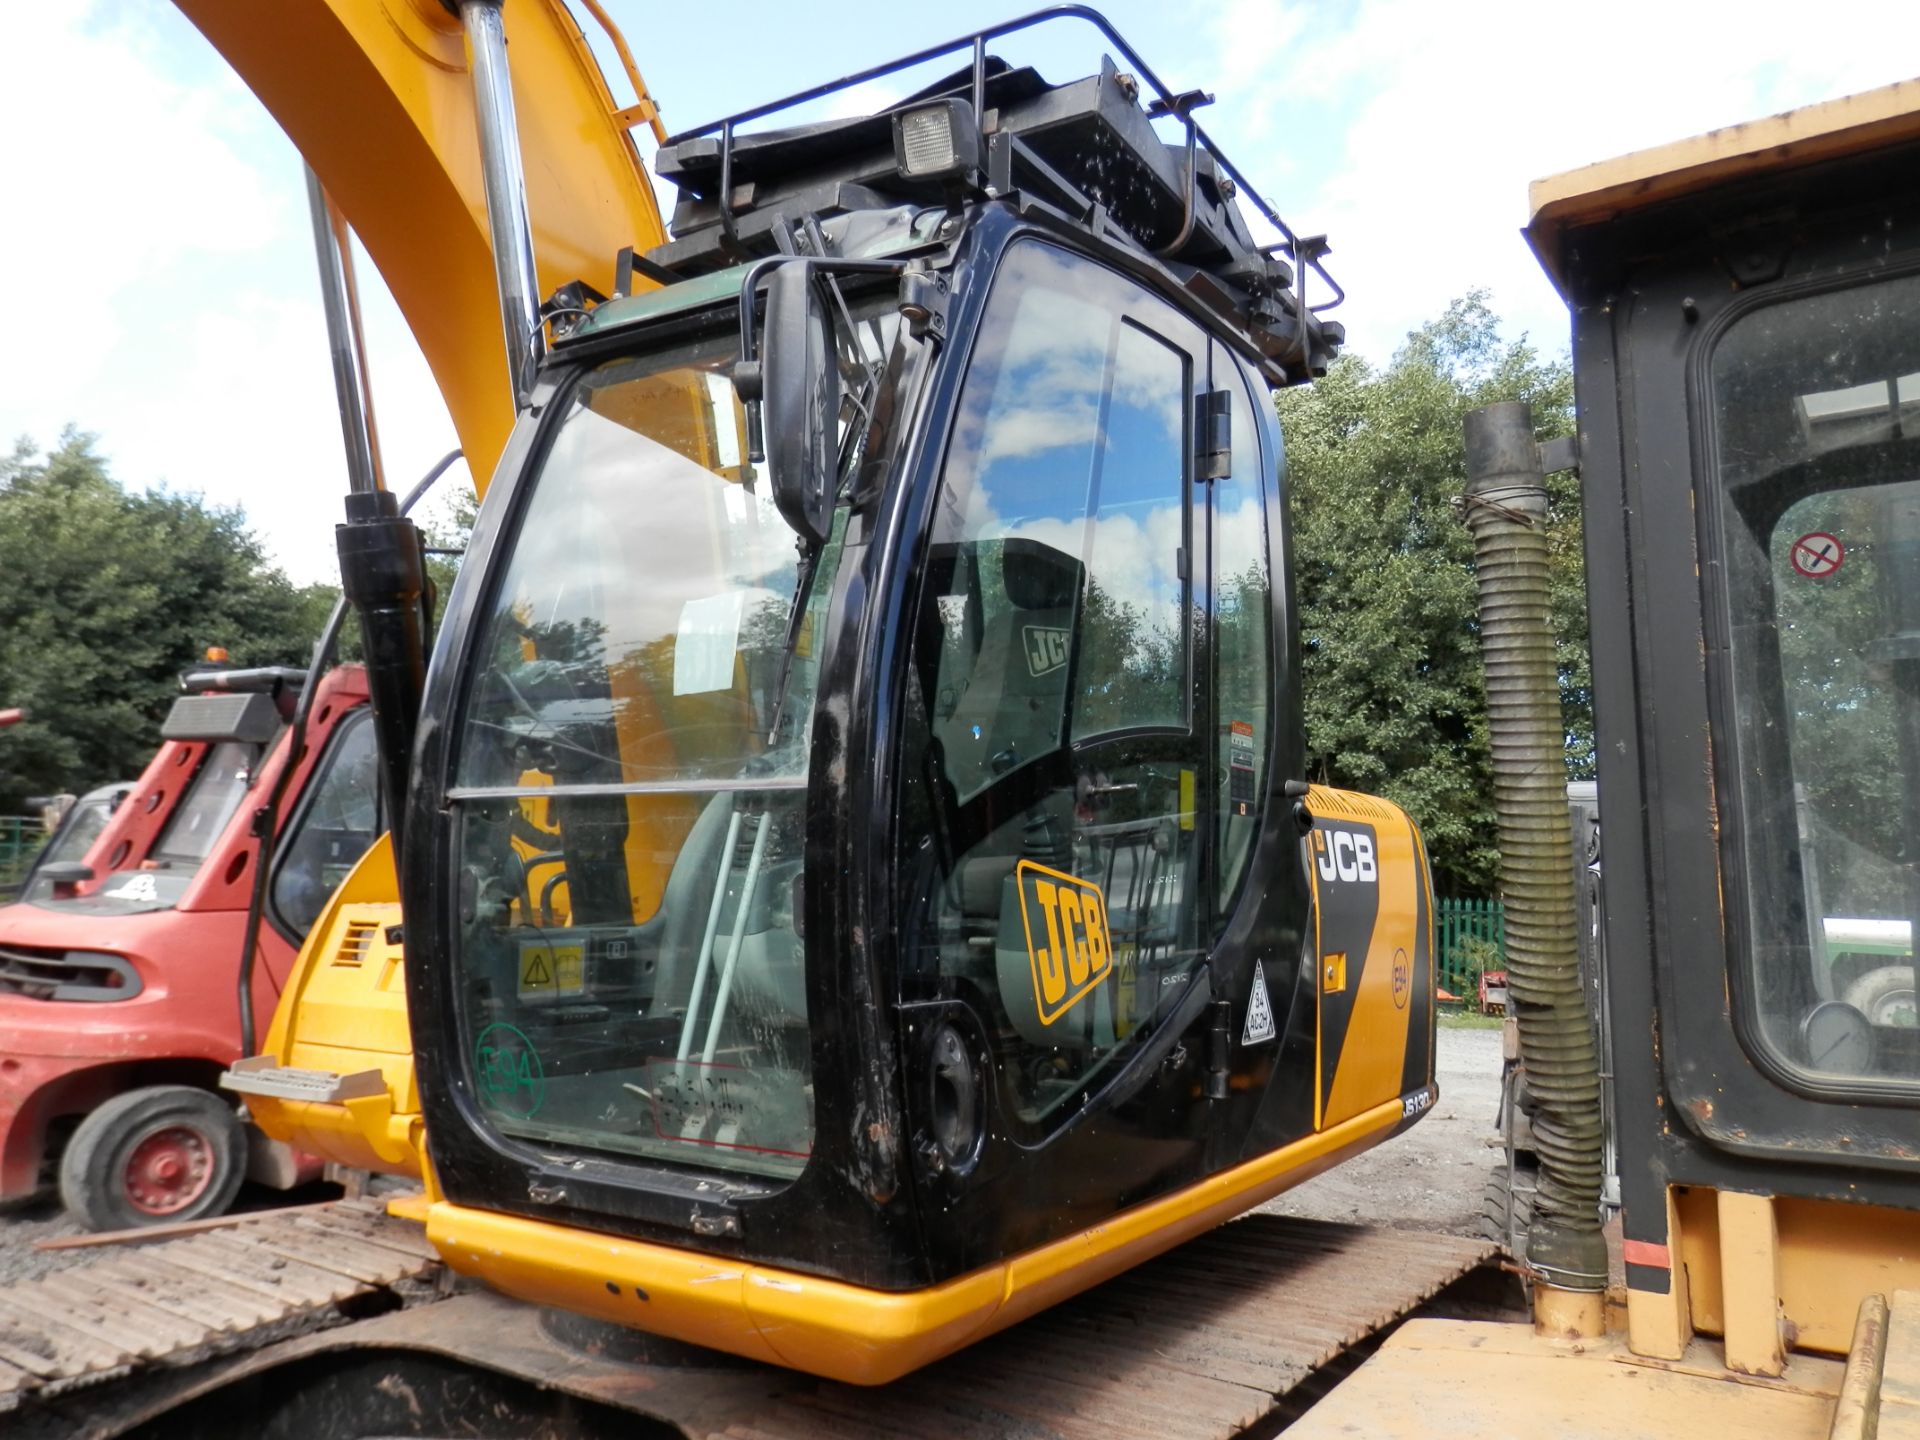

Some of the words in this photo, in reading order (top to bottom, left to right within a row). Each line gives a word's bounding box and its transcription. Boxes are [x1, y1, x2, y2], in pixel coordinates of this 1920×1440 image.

[1319, 829, 1377, 882] JCB
[1035, 879, 1106, 1005] JCB
[482, 1046, 535, 1096] E94
